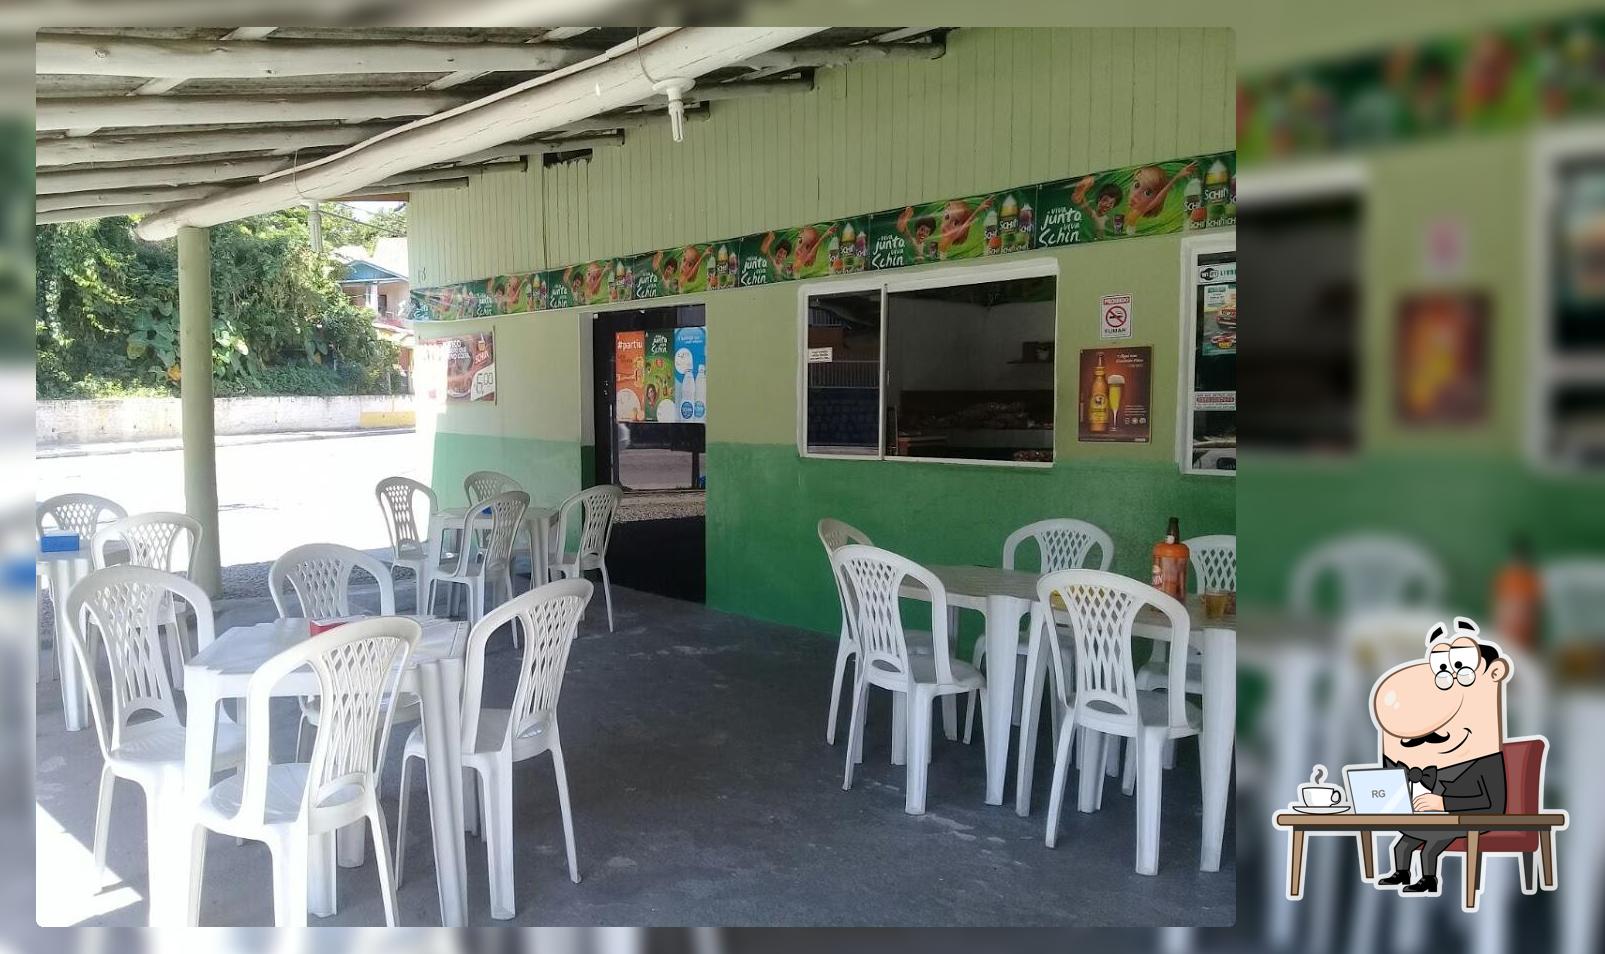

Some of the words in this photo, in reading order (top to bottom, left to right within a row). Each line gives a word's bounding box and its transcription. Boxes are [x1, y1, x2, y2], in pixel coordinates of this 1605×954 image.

[1040, 207, 1082, 232] junto
[872, 235, 904, 256] junto
[1038, 226, 1080, 248] Schin
[871, 252, 904, 271] Schin
[617, 339, 643, 352] #partiu
